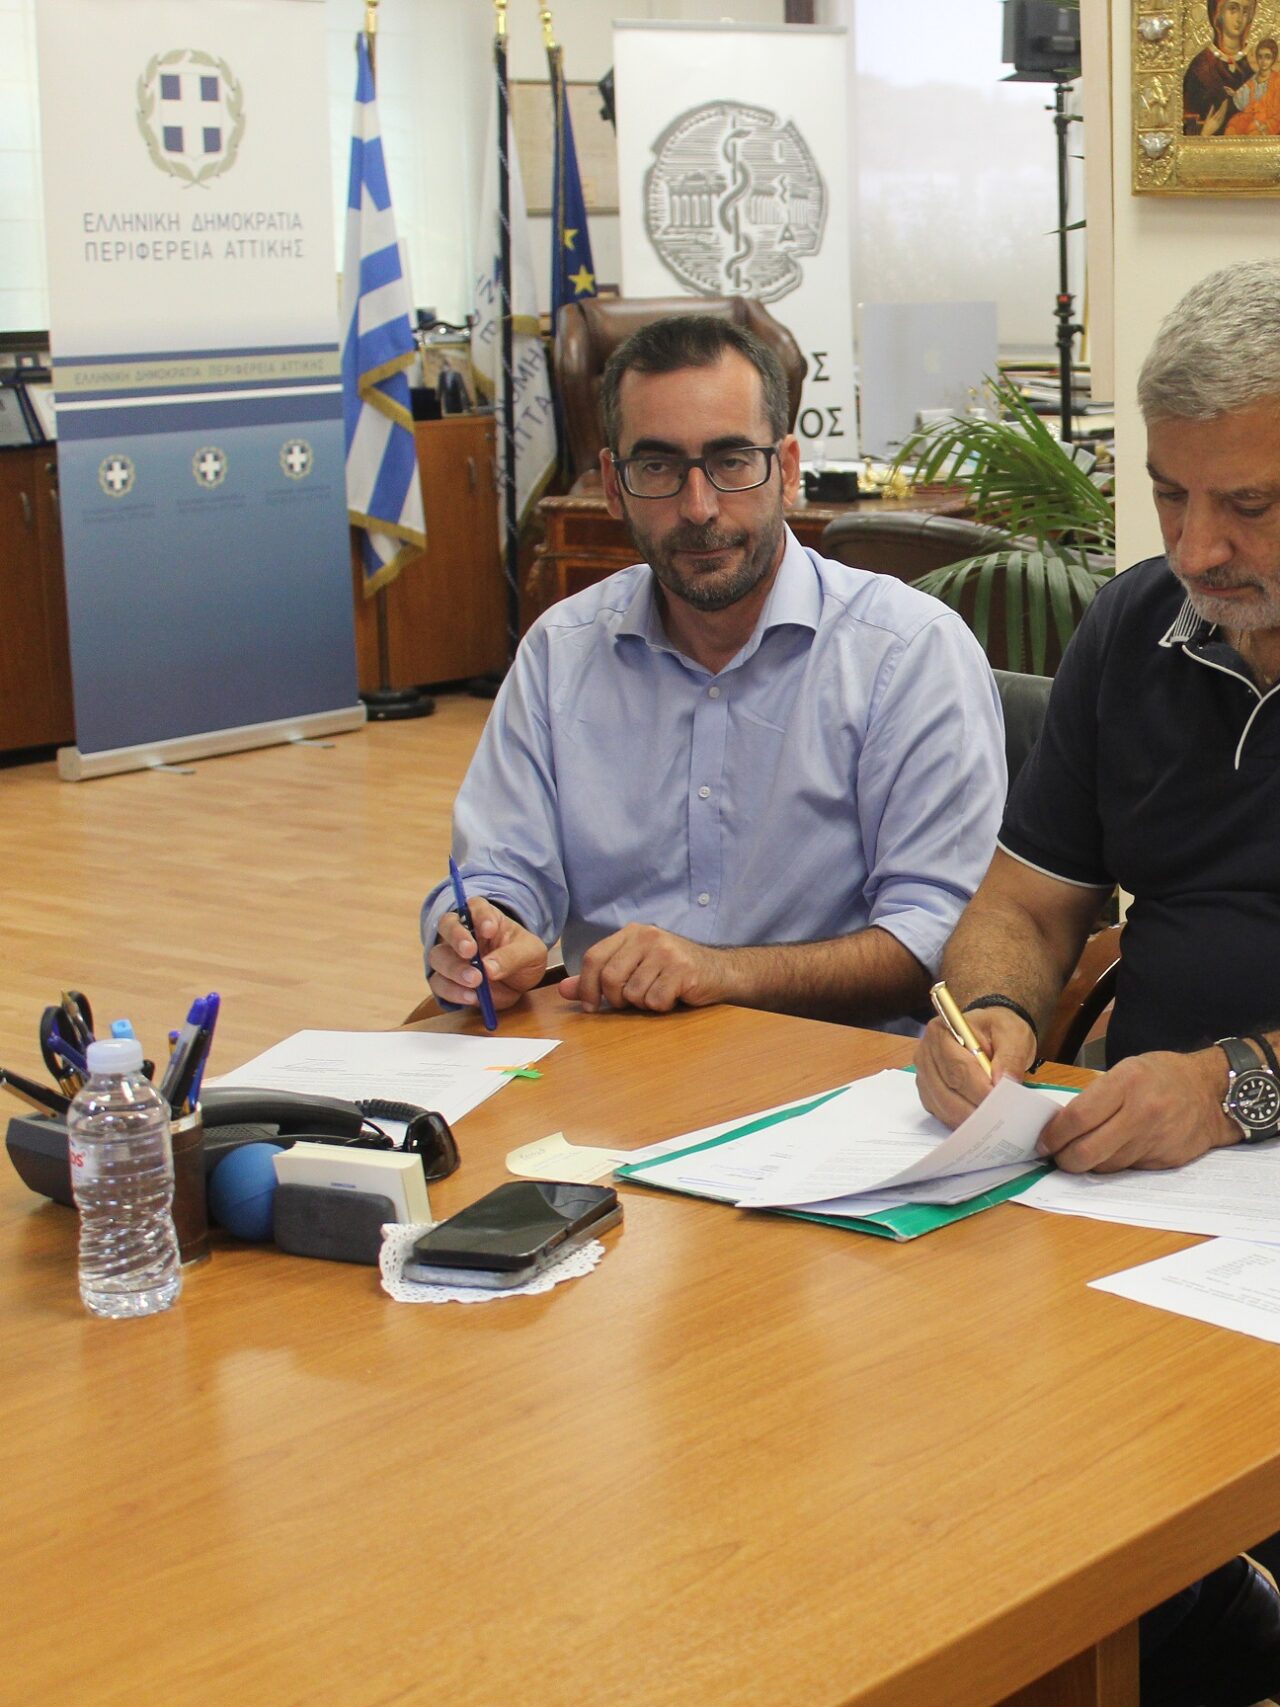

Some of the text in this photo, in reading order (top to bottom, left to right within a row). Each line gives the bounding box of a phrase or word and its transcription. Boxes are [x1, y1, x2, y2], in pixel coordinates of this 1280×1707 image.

[83, 211, 303, 233] ΕΛΛΗΝΙΚΗ ΔΗΜΟΚΡΑΤΙΑ
[85, 239, 305, 262] ΠΕΡΙΦΕΡΕΙΑ ΑΤΤΙΚΗΣ
[73, 359, 324, 386] ΕΛΛΗΝΙΚΗ ΔΗΜΟΚΡΑΤΙΑ ΠΕΡΙΦΕΡΕΙΑ ΑΤΤΙΚΗΣ
